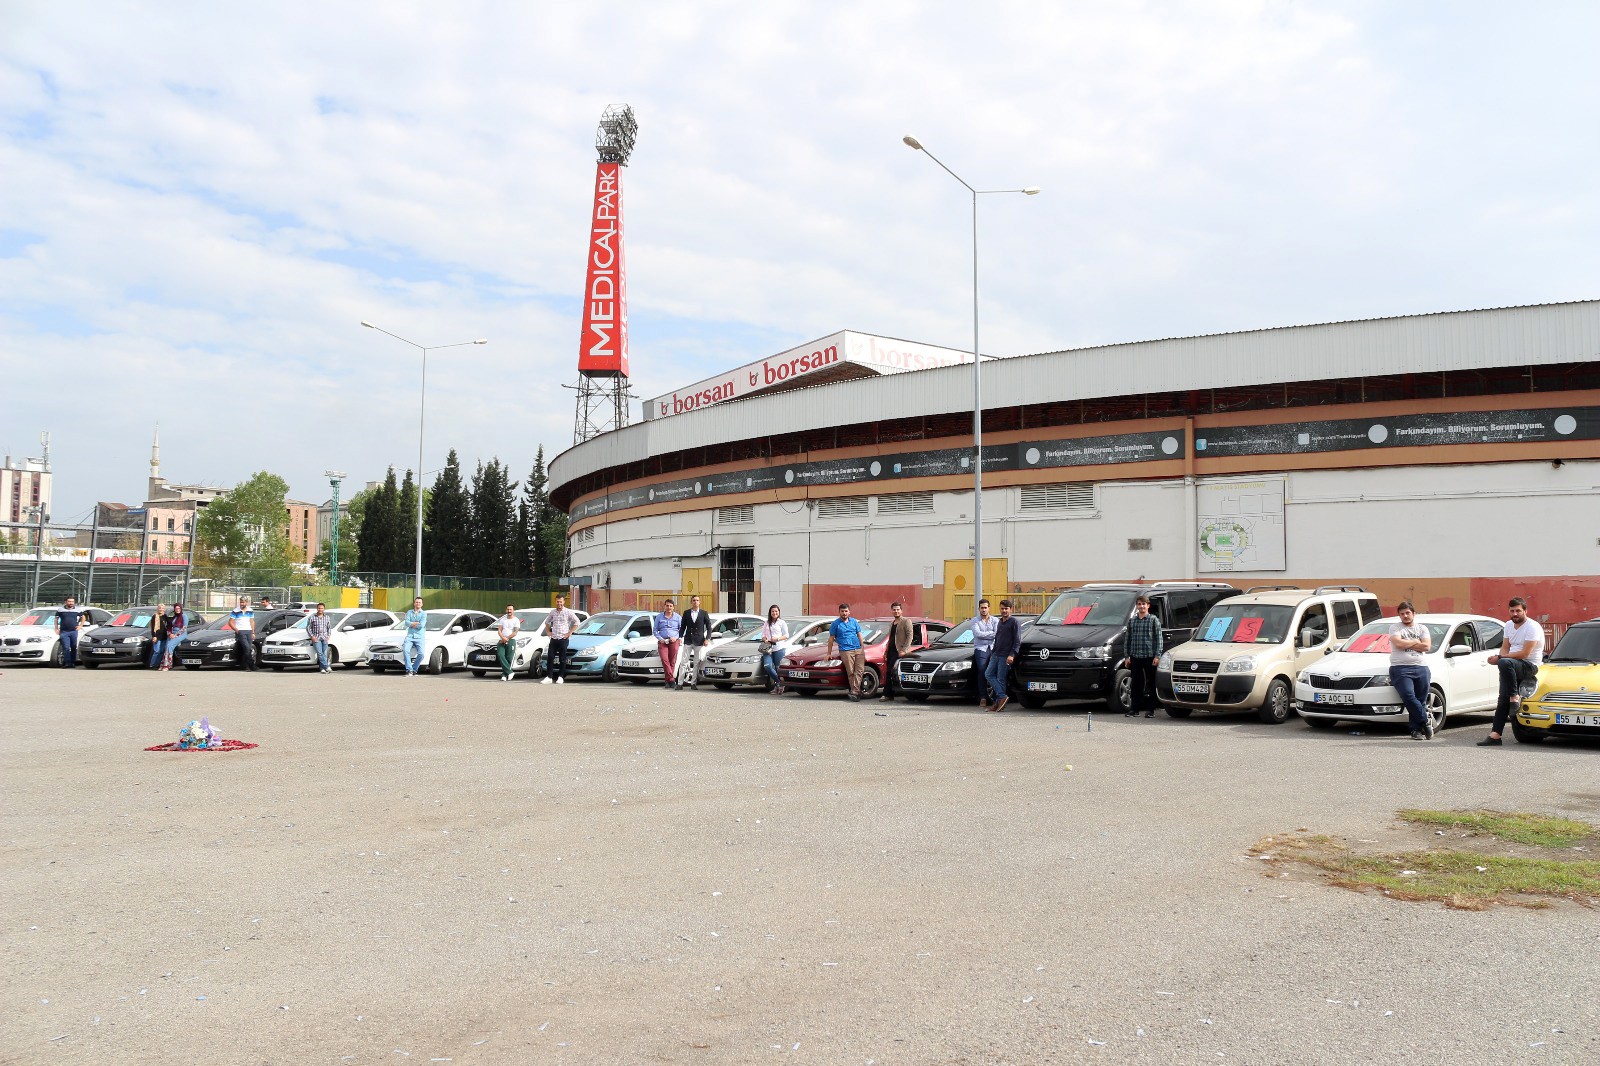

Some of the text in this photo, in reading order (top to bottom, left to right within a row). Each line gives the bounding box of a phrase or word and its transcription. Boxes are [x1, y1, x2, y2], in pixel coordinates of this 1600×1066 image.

[763, 344, 839, 385] borsan
[672, 381, 735, 414] borsan
[1490, 422, 1545, 432] Sorumluyum.
[1178, 684, 1186, 692] 55
[1318, 694, 1353, 703] 55 AOC 14
[1560, 714, 1570, 724] 55
[1576, 715, 1586, 725] AJ
